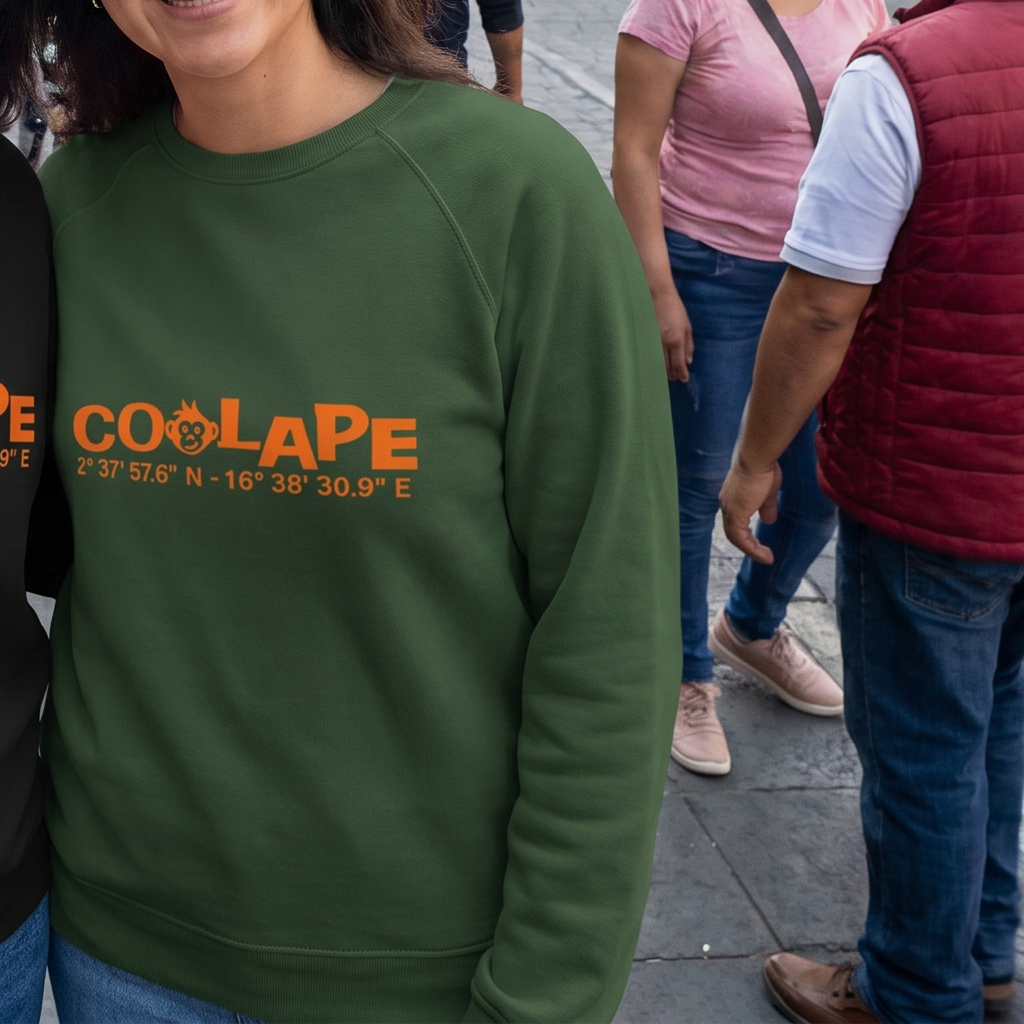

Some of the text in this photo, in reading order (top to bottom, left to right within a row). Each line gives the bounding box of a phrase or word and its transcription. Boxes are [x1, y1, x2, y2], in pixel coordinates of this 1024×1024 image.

[20, 448, 30, 468] E
[77, 456, 94, 476] 2°
[98, 458, 125, 479] 37'
[129, 461, 178, 484] 57.6"
[185, 466, 203, 487] N
[225, 469, 264, 492] 16°
[271, 472, 309, 495] 38'
[316, 474, 386, 498] 30.9"
[394, 477, 411, 499] E
